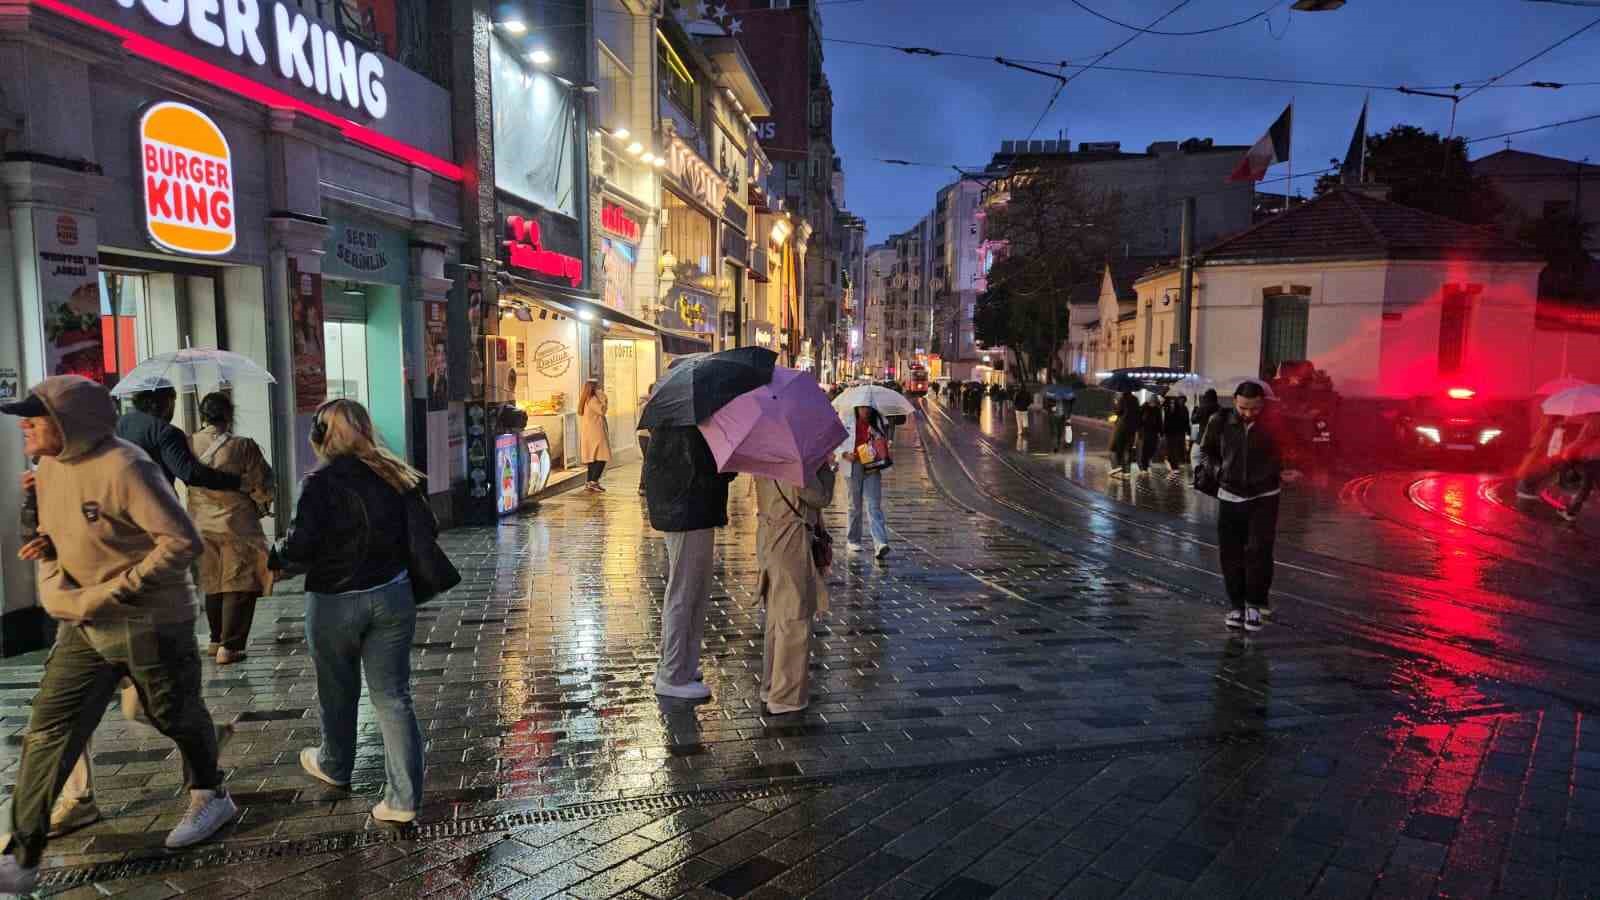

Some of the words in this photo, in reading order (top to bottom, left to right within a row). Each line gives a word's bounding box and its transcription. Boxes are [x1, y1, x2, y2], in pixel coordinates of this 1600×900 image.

[274, 2, 387, 119] KING
[144, 143, 229, 190] BURGER
[147, 175, 232, 229] KING
